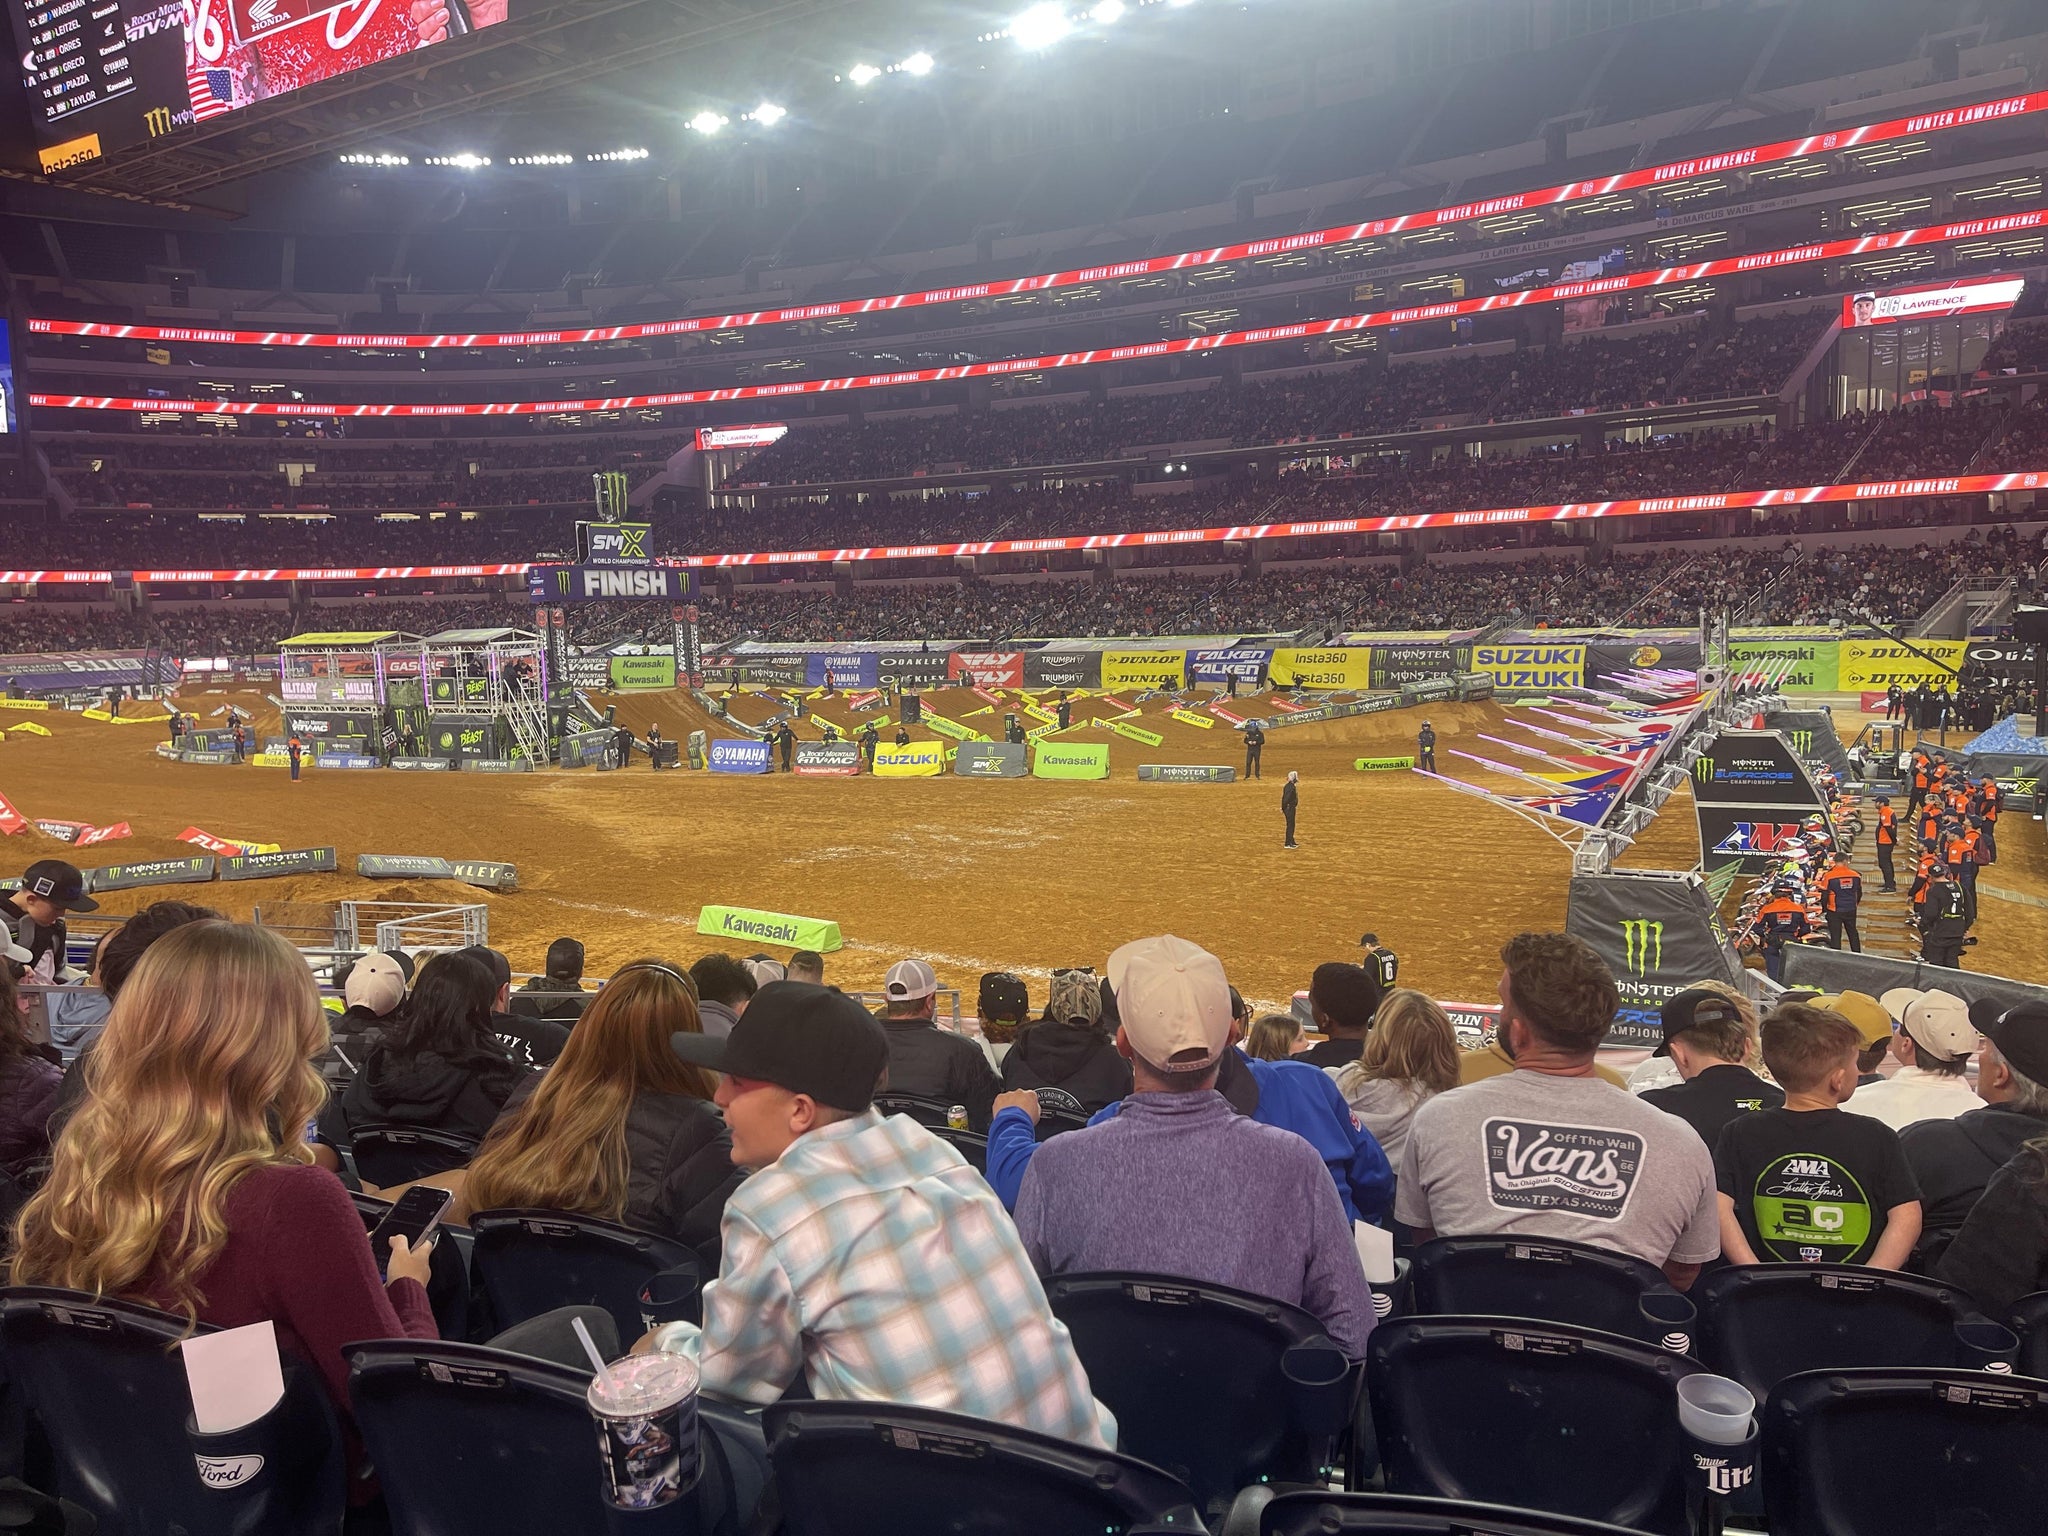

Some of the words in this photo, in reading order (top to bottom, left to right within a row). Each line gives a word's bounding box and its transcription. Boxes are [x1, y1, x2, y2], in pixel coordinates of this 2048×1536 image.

[51, 0, 86, 18] WAGEMAN
[91, 2, 119, 20] Kawasaki
[55, 19, 81, 37] LEITZEL
[251, 11, 291, 33] HONDA
[99, 39, 127, 57] Kawasaki
[62, 56, 86, 72] GRECO
[66, 73, 91, 91] PIAZZA
[106, 76, 134, 93] Kawasaki
[69, 90, 97, 108] TAYLOR
[1907, 112, 1954, 132] HUNTER
[1958, 98, 2026, 122] LAWRENCE
[1823, 135, 1837, 148] 96
[1654, 162, 1695, 180] HUNTER
[1698, 150, 1756, 172] LAWRENCE
[1436, 206, 1471, 222] HUNTER
[1474, 196, 1524, 217] LAWRENCE
[1656, 220, 1668, 229] 94
[1726, 203, 1755, 217] WARE
[1945, 222, 1983, 237] HUNTER
[1987, 213, 2041, 231] LAWRENCE
[1248, 241, 1279, 256] HUNTER
[1281, 232, 1324, 249] LAWRENCE
[1479, 251, 1489, 259] 73
[1492, 245, 1521, 257] LARRY
[1522, 241, 1550, 252] ALLEN
[1737, 255, 1772, 270] HUNTER
[1775, 247, 1823, 263] LAWRENCE
[1335, 272, 1364, 283] EMMITT
[1366, 268, 1389, 278] SMITH
[1553, 285, 1584, 298] HUNTER
[1586, 278, 1629, 293] LAWRENCE
[1391, 310, 1418, 322] HUNTER
[1420, 304, 1458, 318] LAWRENCE
[1878, 297, 1901, 317] 96
[1903, 295, 1967, 310] LAWRENCE
[2024, 474, 2038, 487] 96
[1856, 484, 1897, 496] HUNTER
[1900, 480, 1959, 494] LAWRENCE
[1639, 500, 1674, 511] HUNTER
[1676, 496, 1726, 510] LAWRENCE
[1454, 512, 1484, 524] HUNTER
[1485, 509, 1529, 522] LAWRENCE
[1291, 524, 1318, 535] HUNTER
[1319, 521, 1357, 533] LAWRENCE
[592, 529, 647, 558] SMX
[583, 569, 668, 597] FINISH
[958, 653, 1011, 666] FLY
[1041, 655, 1070, 664] TRIUMPH
[1197, 650, 1266, 662] FALKEN
[1295, 653, 1347, 664] Insta360
[1391, 649, 1450, 661] MONSTER
[1477, 649, 1581, 665] SUZUKI
[1728, 648, 1815, 661] Kawasaki
[1868, 647, 1959, 659] DUNLOP
[623, 660, 665, 669] Kawasaki
[771, 657, 802, 665] amazon
[833, 657, 861, 666] YAMAHA
[898, 658, 946, 666] OAKLEY
[1118, 656, 1180, 665] DUNLOP
[750, 669, 792, 680] MONSTER
[1192, 664, 1260, 676] FALKEN
[622, 675, 664, 684] Kawasaki
[833, 673, 861, 683] YAMAHA
[1040, 673, 1070, 682] TRIUMPH
[1118, 674, 1178, 683] DUNLOP
[1494, 671, 1579, 687] UZUKI
[1867, 673, 1958, 685] DUNLOP
[857, 694, 878, 706] HONDA
[1359, 699, 1393, 712] MONSTER
[1028, 706, 1058, 723] SUZUKI
[1176, 711, 1211, 726] SUZUKI
[1216, 709, 1242, 723] HONDA
[1287, 710, 1323, 722] MONSTER
[931, 720, 963, 737] Kawasaki
[1028, 723, 1060, 739] SUZUKI
[1121, 725, 1158, 742] Kawasaki
[385, 733, 395, 745] 30
[461, 732, 484, 747] BEAST
[725, 749, 766, 761] YAMAHA
[824, 750, 857, 758] MOUNTAIN
[877, 754, 938, 766] SUZUKI
[1043, 755, 1097, 767] Kawasaki
[972, 759, 1003, 771] SMX
[1362, 759, 1409, 770] Kawasaki
[1732, 758, 1775, 767] MONSTER
[1163, 767, 1206, 777] MONSTER
[85, 827, 113, 842] FLY
[188, 834, 226, 851] FLY
[248, 851, 309, 864] MONSTER
[258, 859, 301, 869] ENERGY
[385, 857, 429, 867] MONSTER
[125, 860, 186, 873] MONSTER
[454, 865, 501, 880] KLEY
[133, 870, 177, 878] ENERGY
[722, 913, 798, 942] Kawasaki
[1385, 961, 1393, 980] 6
[1621, 997, 1663, 1006] NERG
[1448, 1013, 1483, 1026] TAIN
[1736, 1099, 1761, 1111] SMX
[1553, 1133, 1578, 1144] Off
[1580, 1135, 1605, 1147] The
[1606, 1137, 1636, 1151] Wall
[1496, 1125, 1618, 1181] Vans
[1620, 1162, 1634, 1171] 66
[1782, 1159, 1830, 1176] AMA
[1520, 1177, 1551, 1188] Original
[1553, 1176, 1620, 1197] SIDESTRIPE
[1531, 1194, 1580, 1208] TEXAS
[1693, 1453, 1729, 1467] Miller
[199, 1460, 244, 1482] Ford
[1696, 1464, 1753, 1495] Lite
